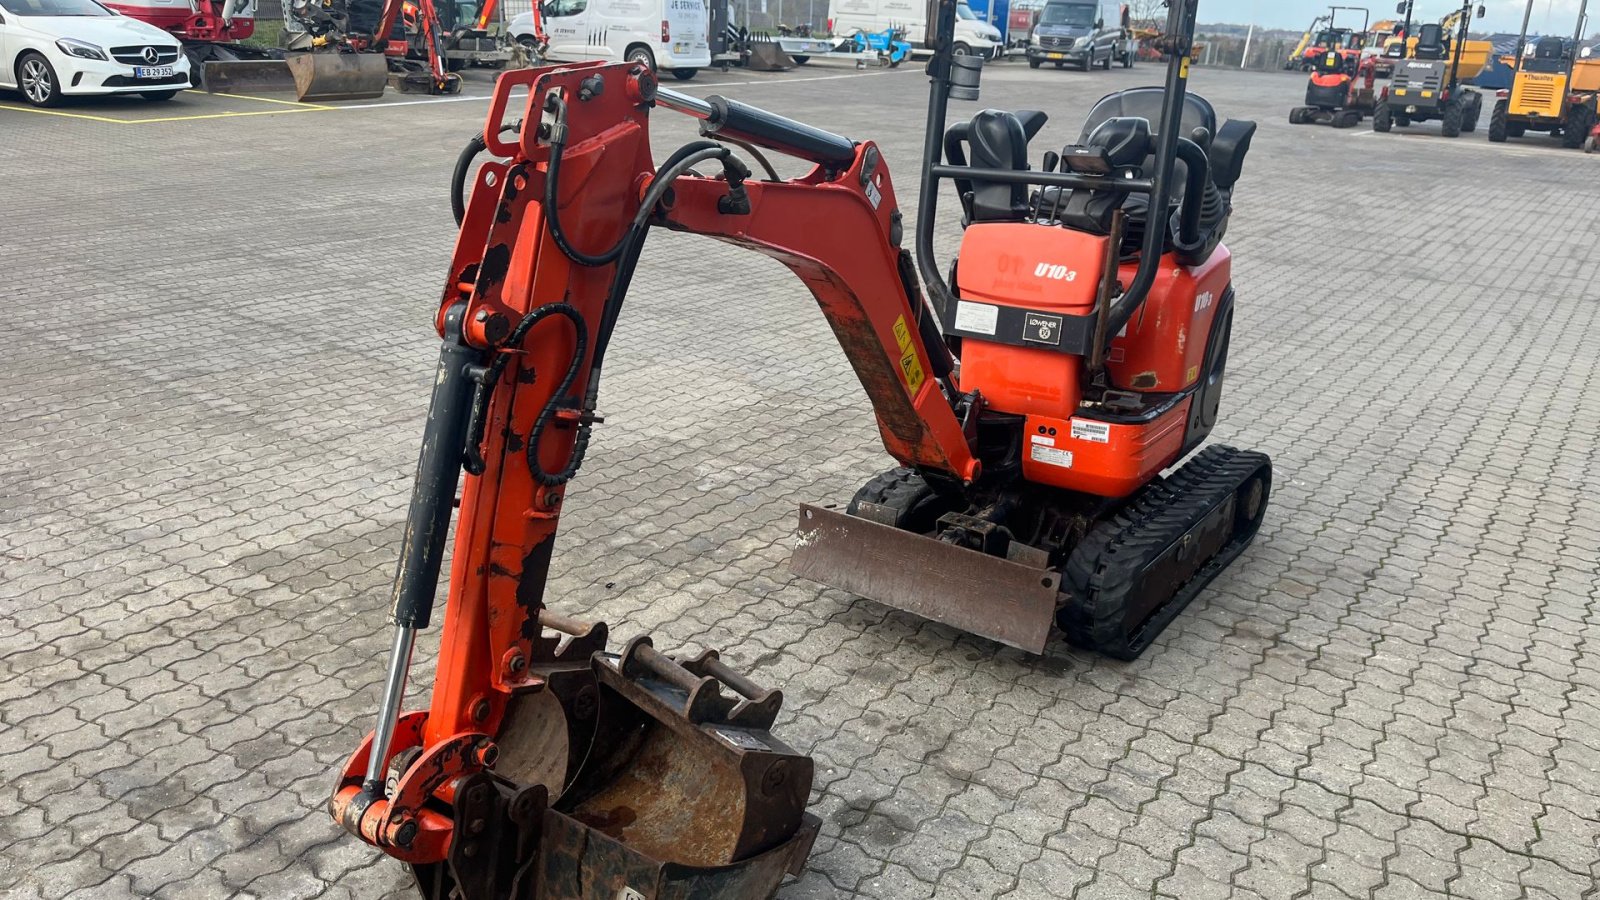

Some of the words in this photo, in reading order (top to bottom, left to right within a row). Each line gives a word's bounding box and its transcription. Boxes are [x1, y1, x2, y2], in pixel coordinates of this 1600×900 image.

[680, 1, 701, 11] SERVICE
[1034, 262, 1077, 281] U10-3
[1029, 318, 1057, 329] LØWENER
